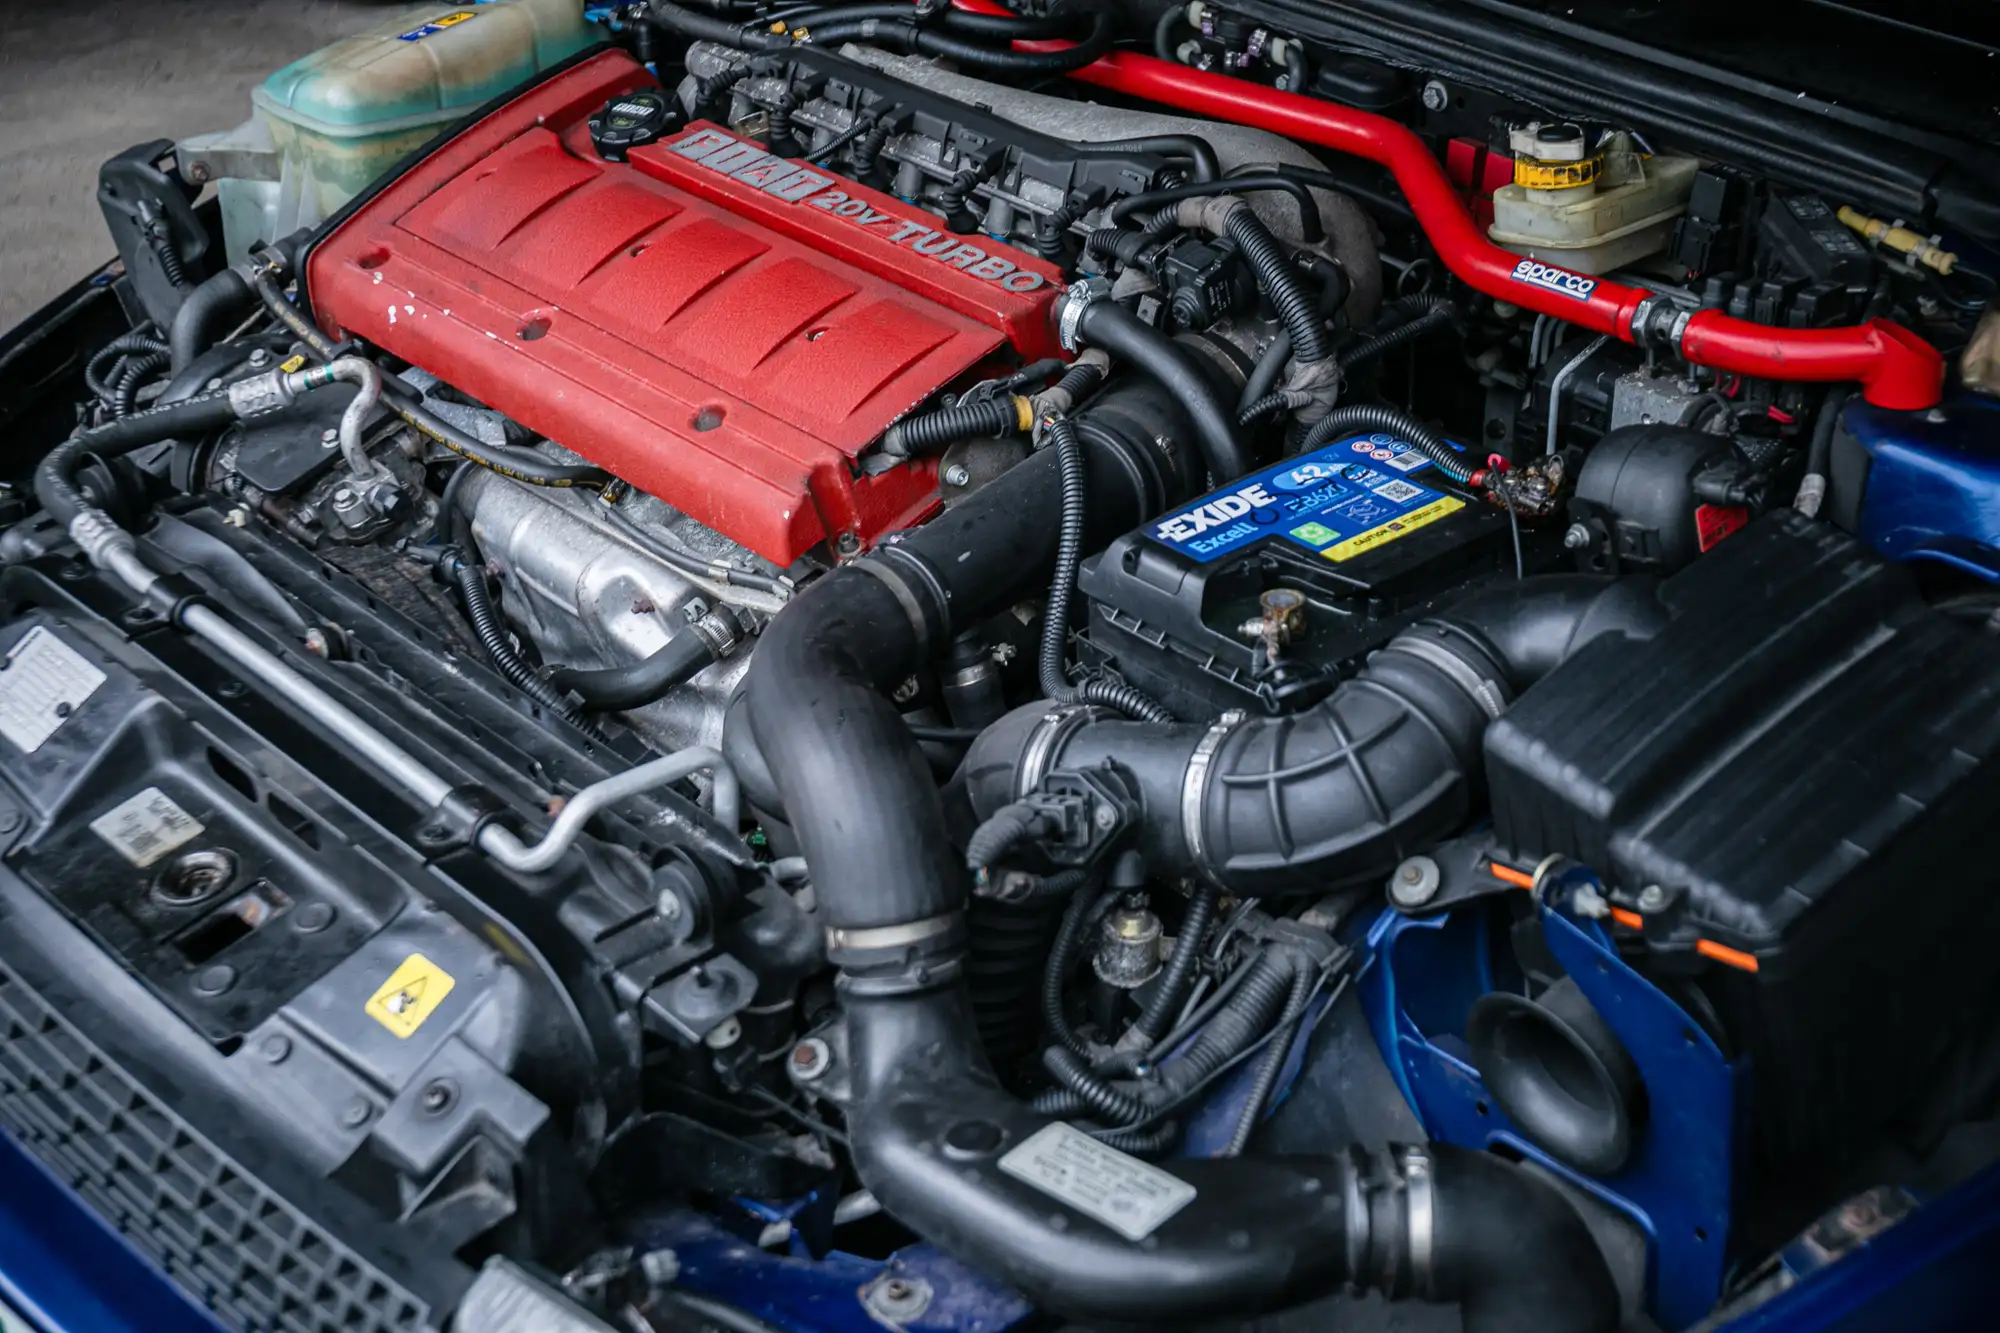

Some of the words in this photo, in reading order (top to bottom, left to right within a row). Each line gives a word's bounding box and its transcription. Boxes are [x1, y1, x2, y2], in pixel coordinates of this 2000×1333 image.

[668, 128, 836, 203] FIAT
[887, 220, 1044, 292] TURBO
[1516, 260, 1595, 293] sparco
[1157, 482, 1277, 543] EXIDE
[1188, 522, 1259, 553] Excell
[1353, 528, 1391, 546] CAUTION
